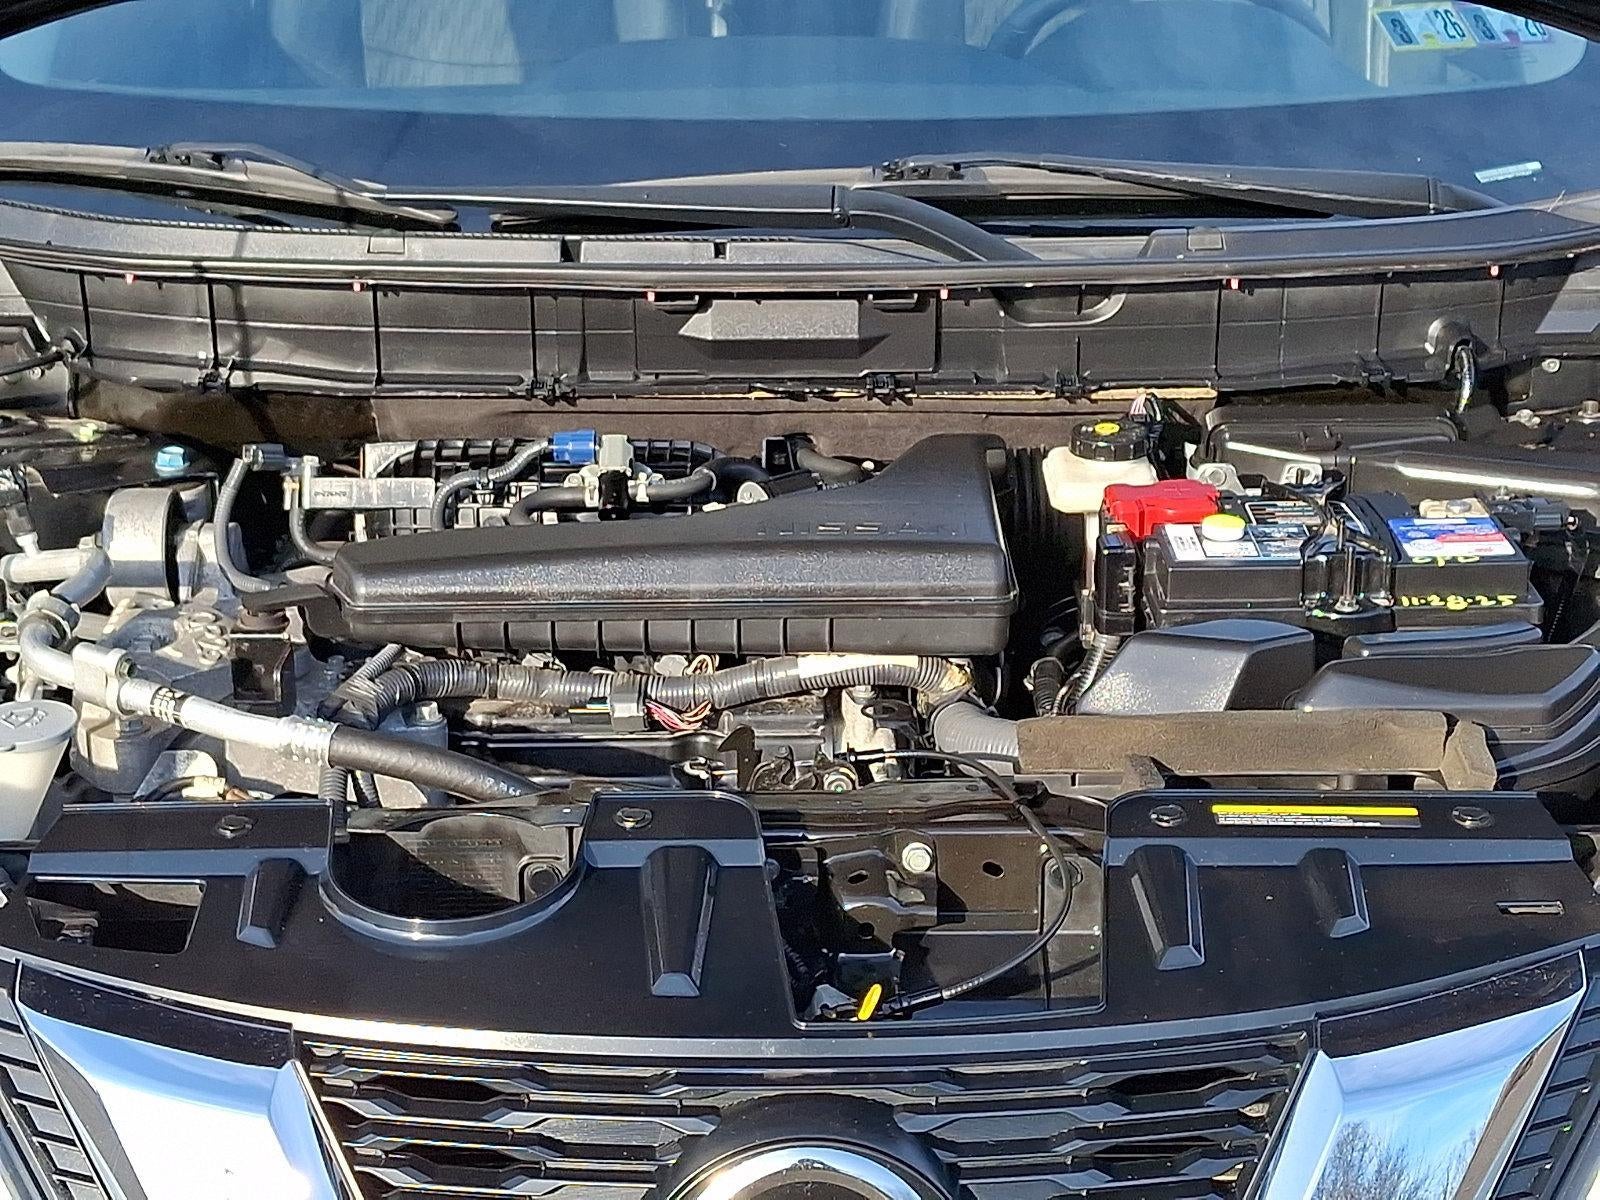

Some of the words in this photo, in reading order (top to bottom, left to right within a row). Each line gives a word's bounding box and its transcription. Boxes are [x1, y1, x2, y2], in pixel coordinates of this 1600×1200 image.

[1390, 17, 1413, 45] 3
[1433, 9, 1467, 39] 26
[1473, 14, 1496, 41] 3
